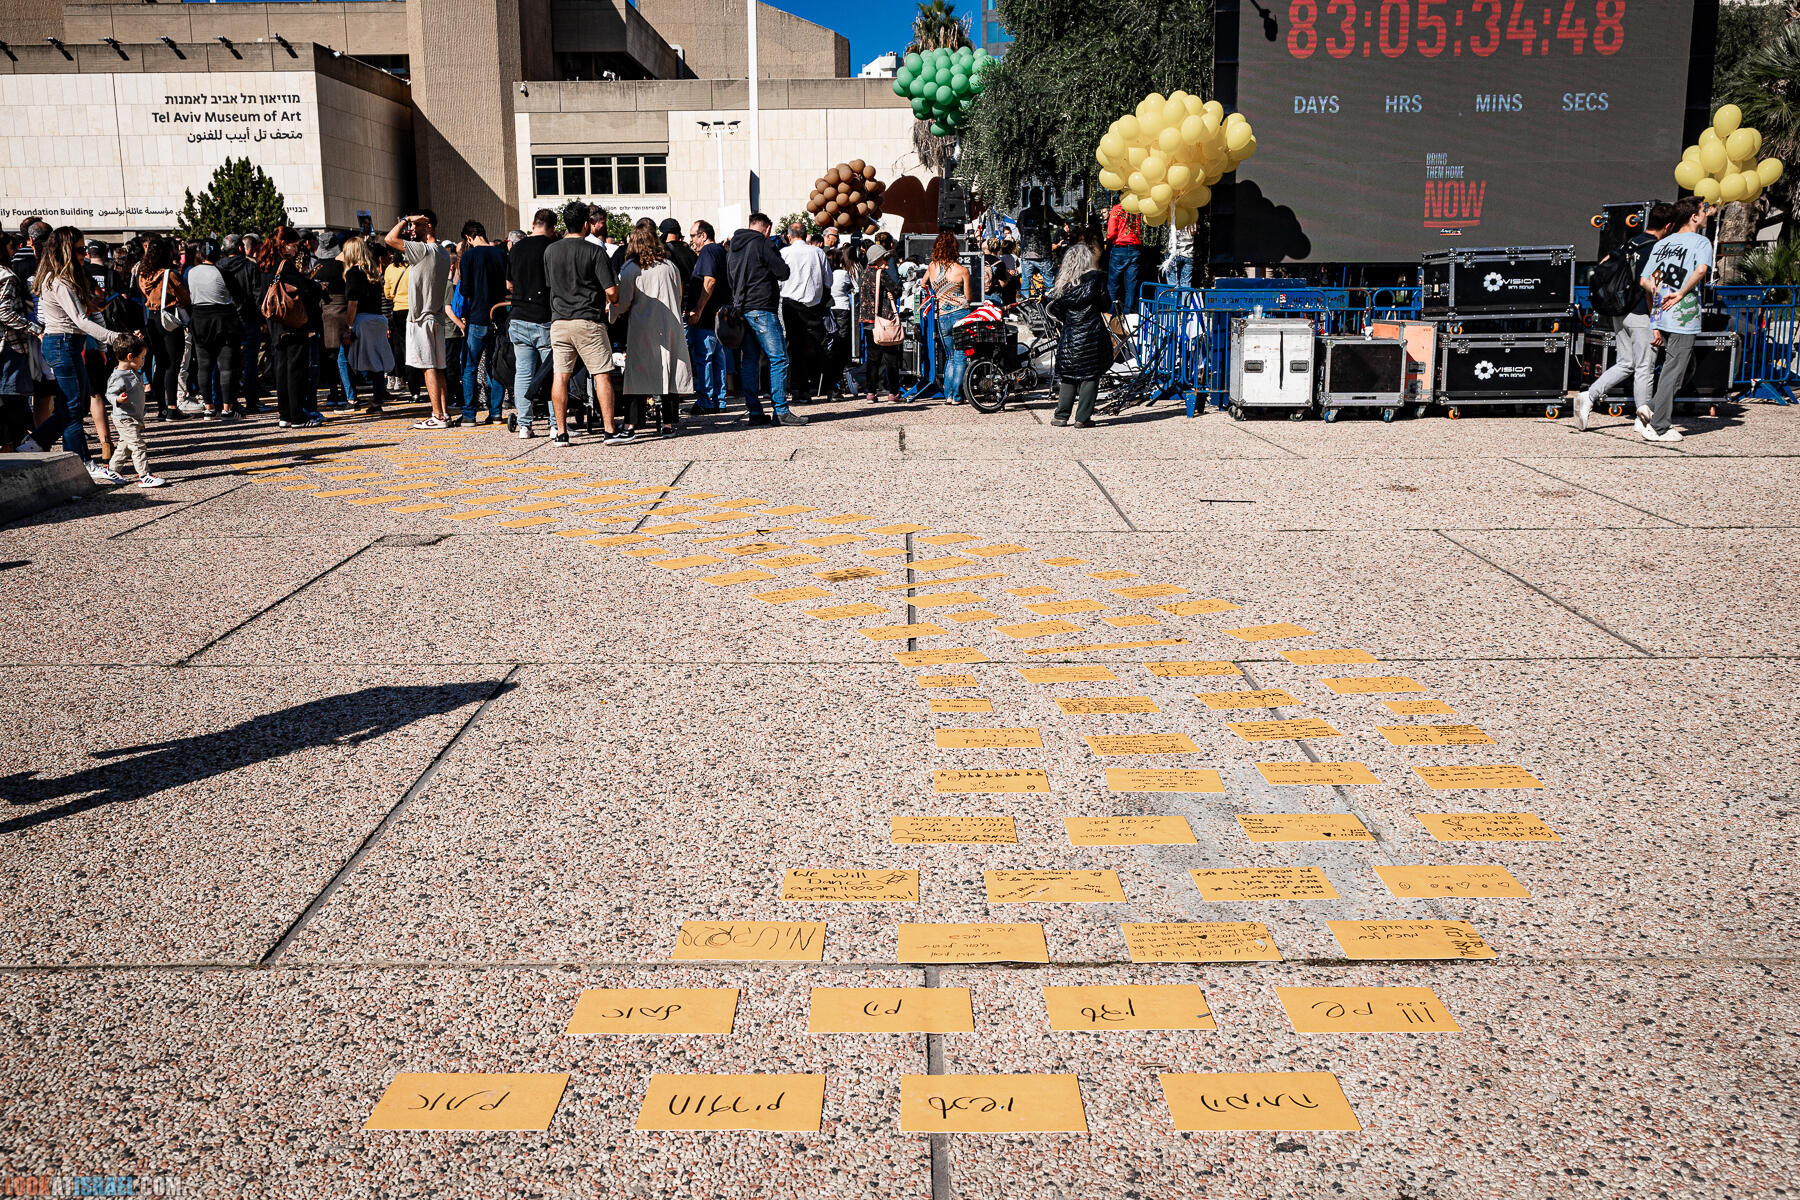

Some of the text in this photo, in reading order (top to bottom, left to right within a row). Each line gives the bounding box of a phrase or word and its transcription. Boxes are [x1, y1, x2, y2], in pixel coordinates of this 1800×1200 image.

[165, 93, 300, 105] מוזיאון תל אביב לאמנות
[1294, 92, 1609, 114] DAYS HRS MINS SECS
[152, 110, 302, 123] Tel Aviv Museum of Art
[188, 127, 303, 143] متحف تل أبيب للفنون
[1426, 166, 1464, 179] THEM HOME
[1424, 180, 1487, 218] NOW
[12, 208, 58, 216] Foundation
[61, 208, 94, 217] Building
[602, 1004, 681, 1020] אבל
[408, 1090, 510, 1111] אתם
[929, 1096, 1013, 1120] עכשיו
[1201, 1093, 1318, 1113] הביתה
